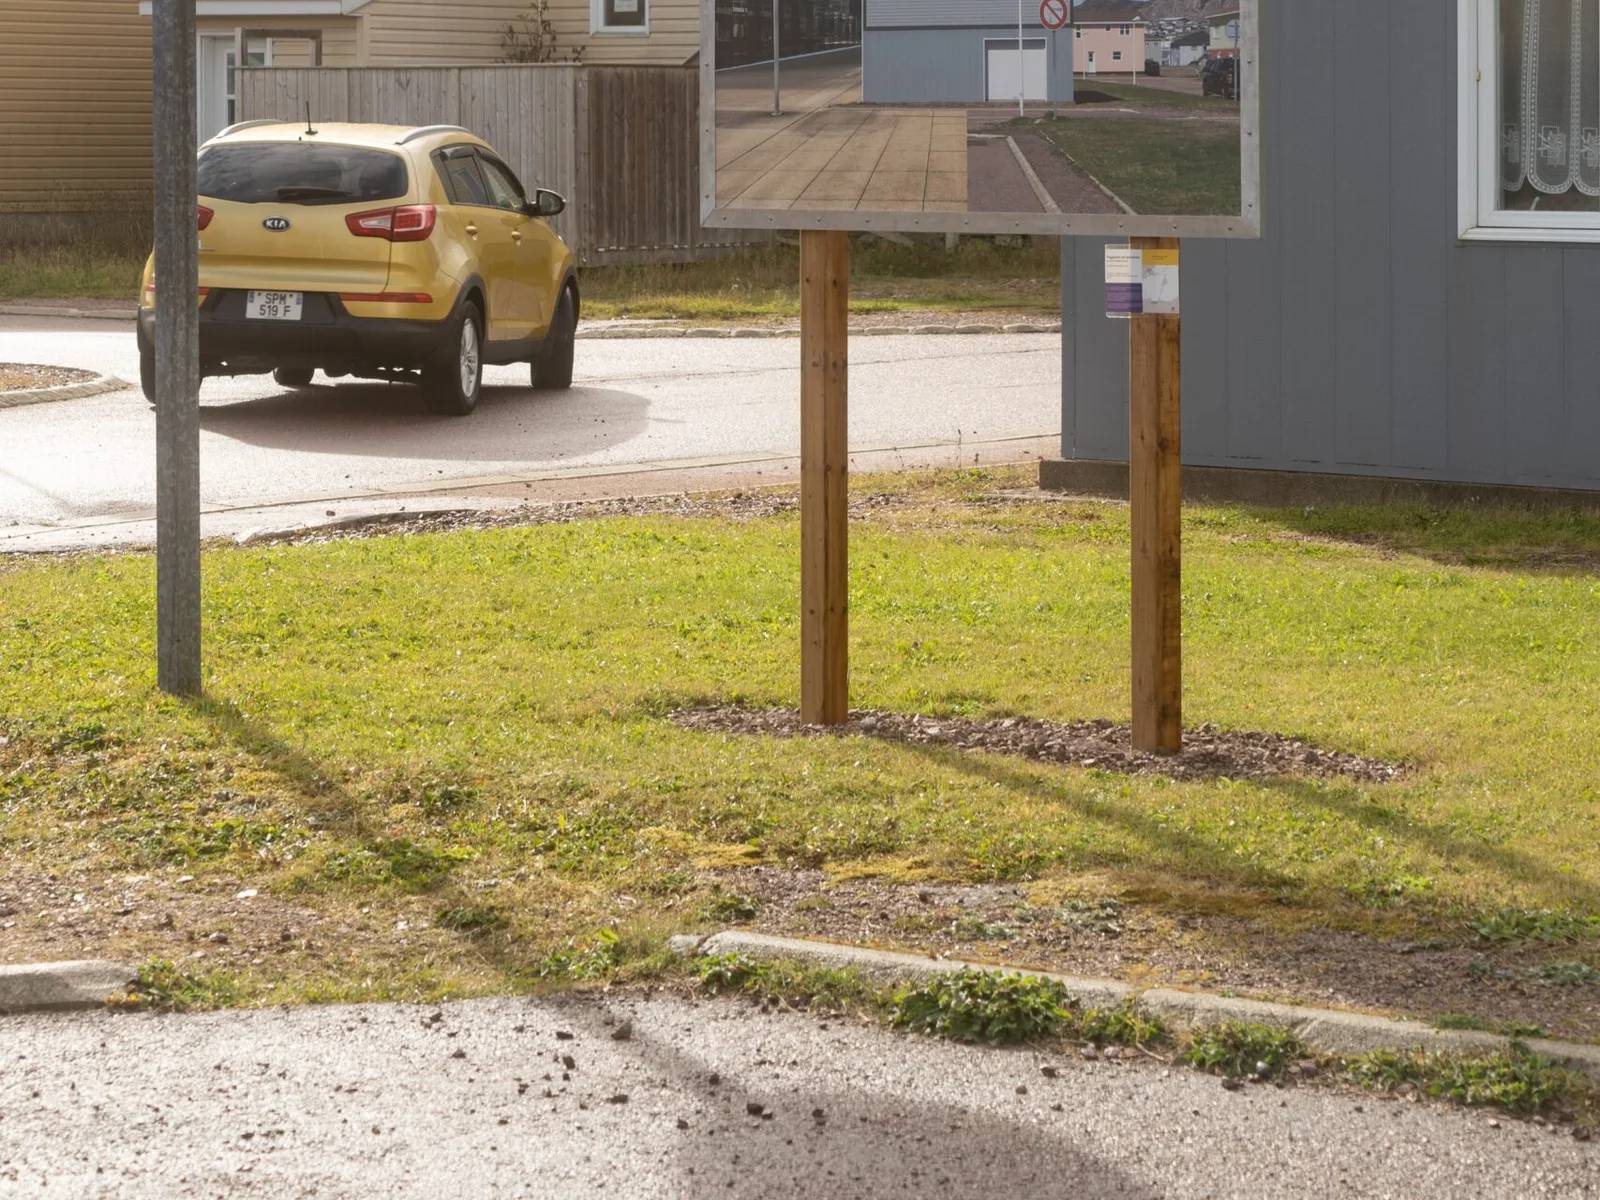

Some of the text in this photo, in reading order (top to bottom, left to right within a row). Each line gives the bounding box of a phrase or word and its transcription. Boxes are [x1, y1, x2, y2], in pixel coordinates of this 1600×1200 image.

[266, 220, 286, 228] KIA
[265, 293, 287, 304] SPM
[259, 304, 291, 316] 519 F
